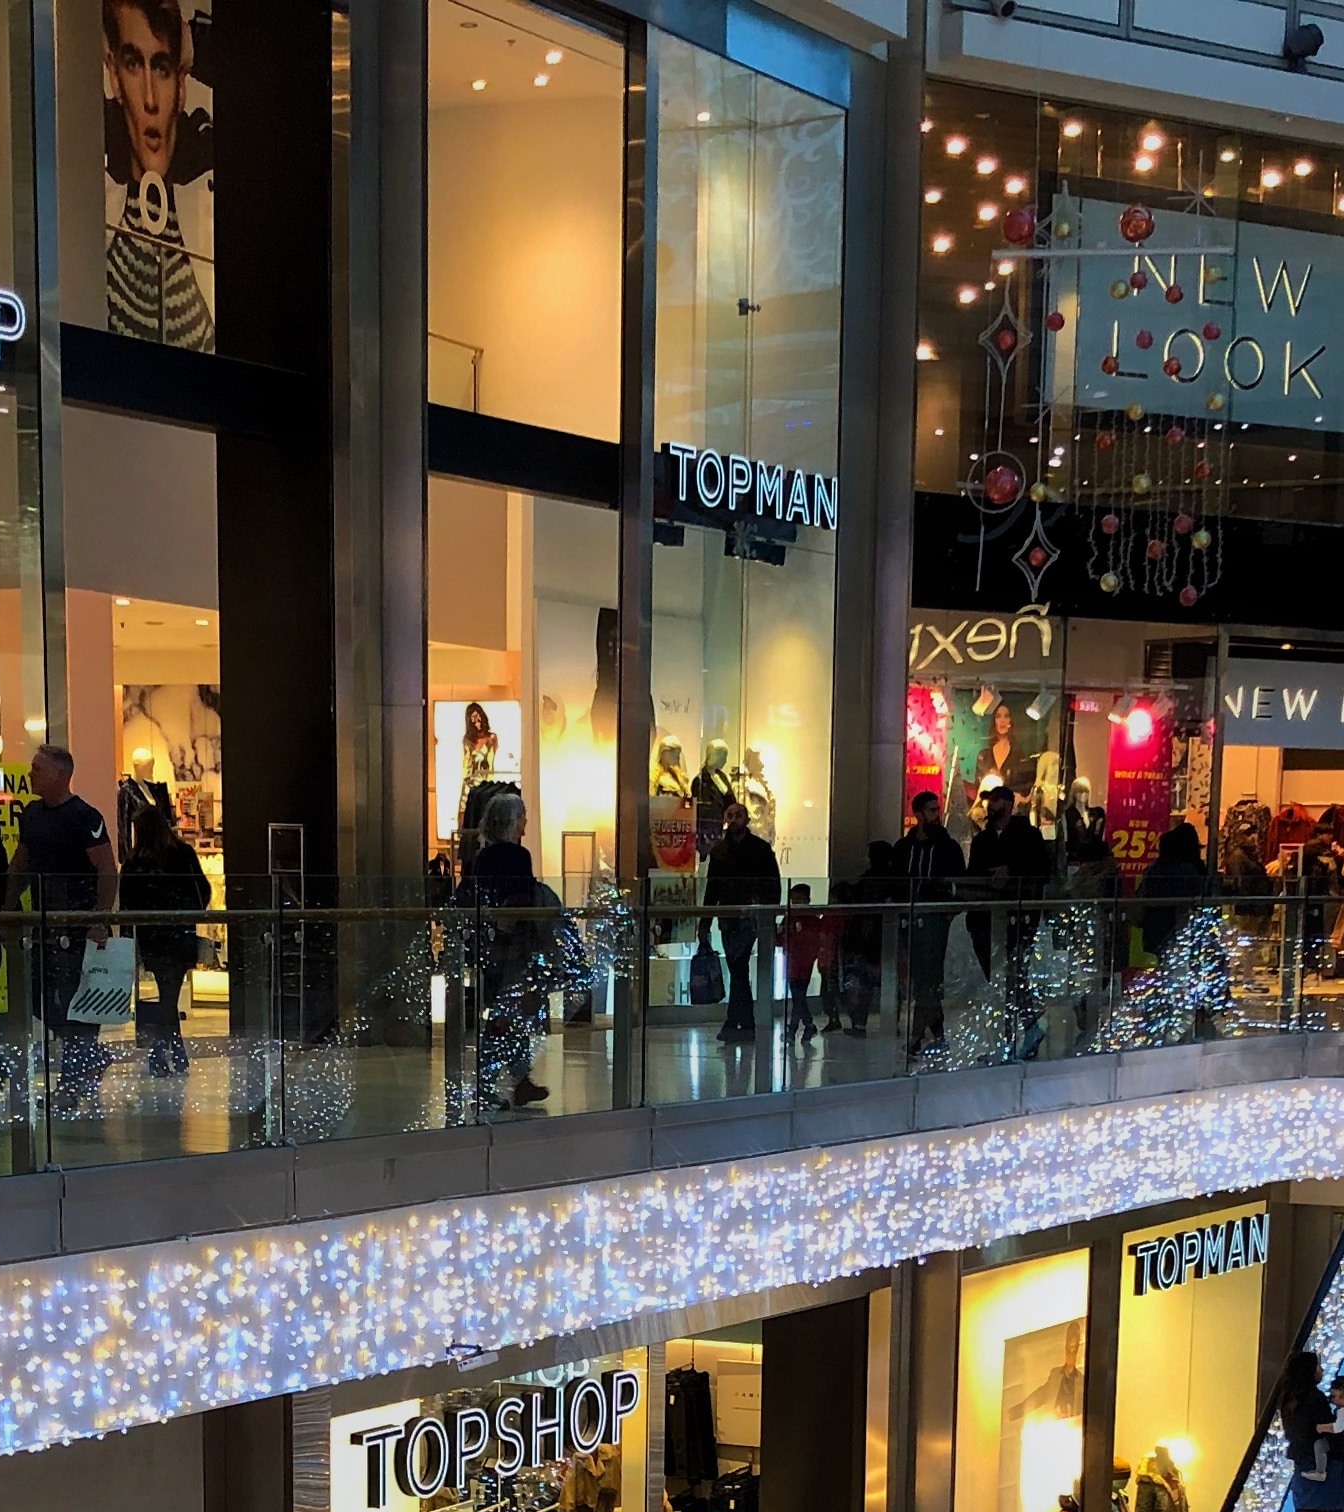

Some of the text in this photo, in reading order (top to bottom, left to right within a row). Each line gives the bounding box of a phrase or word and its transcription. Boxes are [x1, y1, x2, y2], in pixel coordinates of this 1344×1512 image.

[1132, 254, 1312, 317] NEW
[1111, 319, 1326, 400] LOOK
[668, 440, 838, 531] TOPMAN
[1224, 685, 1318, 721] NEW
[1132, 1212, 1271, 1296] TOPMAN
[353, 1370, 640, 1509] TOPSHOP
